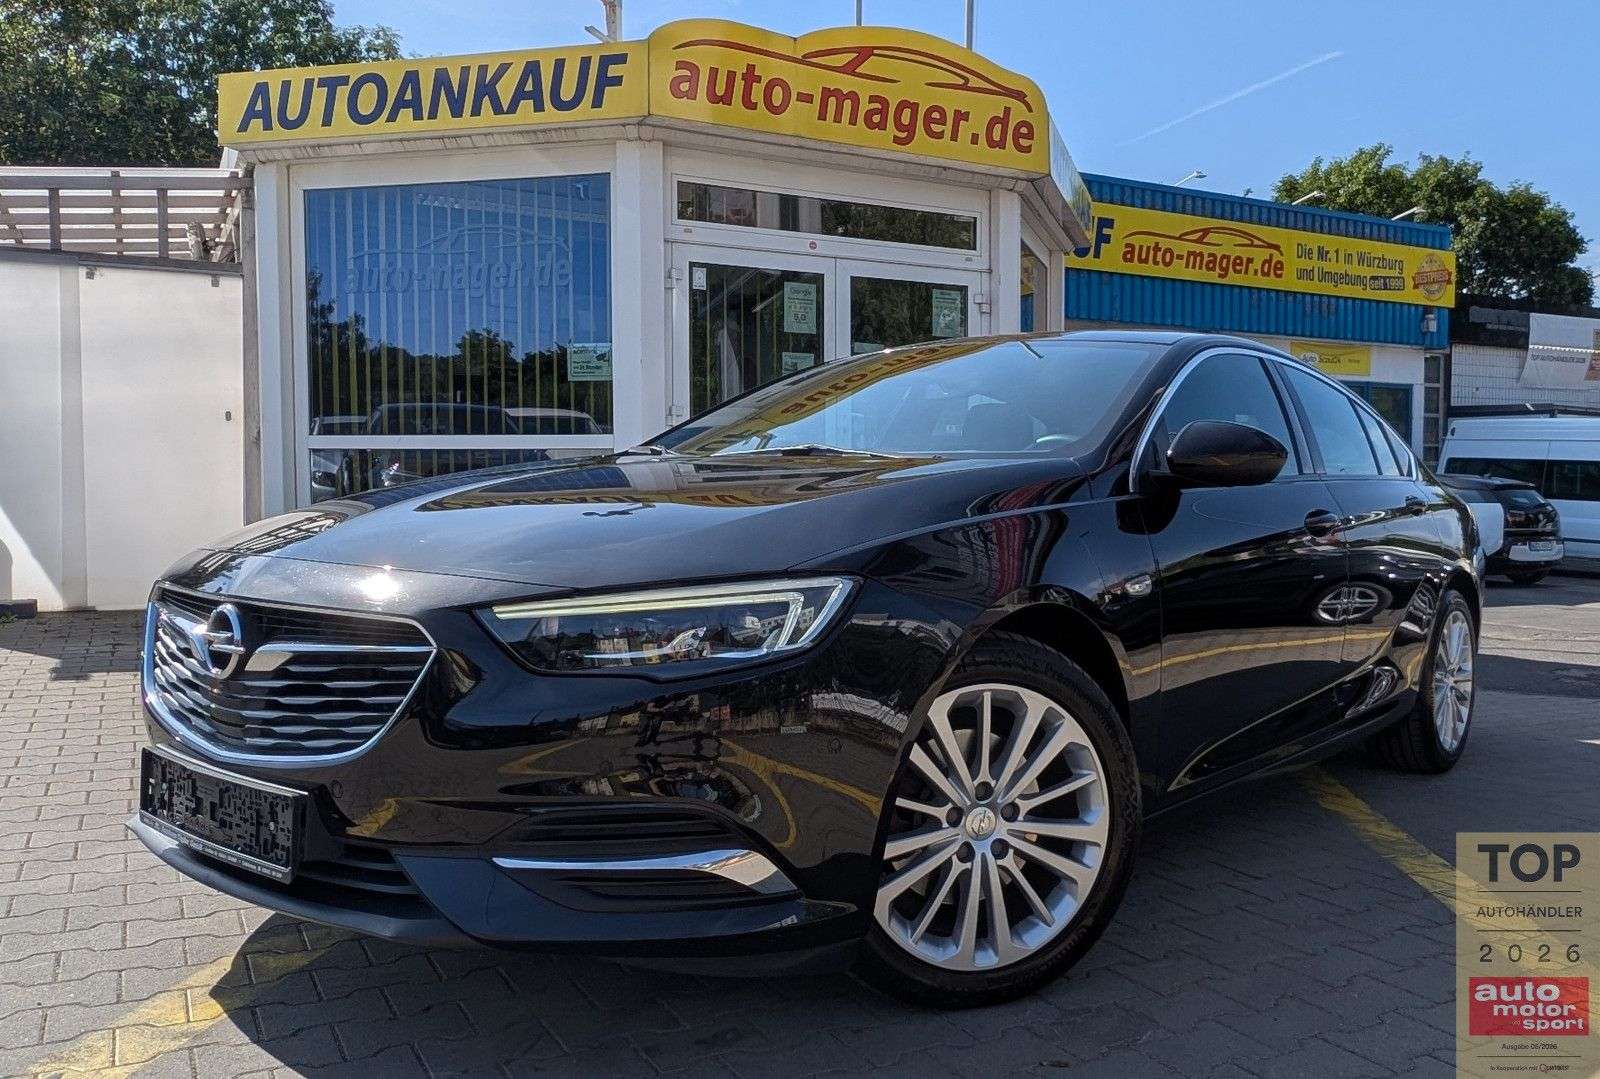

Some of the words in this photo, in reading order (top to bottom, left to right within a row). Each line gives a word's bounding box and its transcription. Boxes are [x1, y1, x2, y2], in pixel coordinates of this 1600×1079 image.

[237, 52, 628, 134] AUTOANKAUF
[668, 58, 1035, 154] auto-mager.de
[1122, 238, 1284, 279] auto-mager.de
[1296, 243, 1313, 260] Die
[1317, 246, 1331, 262] Nr.
[1334, 248, 1339, 263] 1
[1344, 250, 1353, 265] in
[1356, 250, 1404, 274] Würzburg
[1296, 266, 1314, 281] und
[1318, 266, 1368, 290] Umgebung
